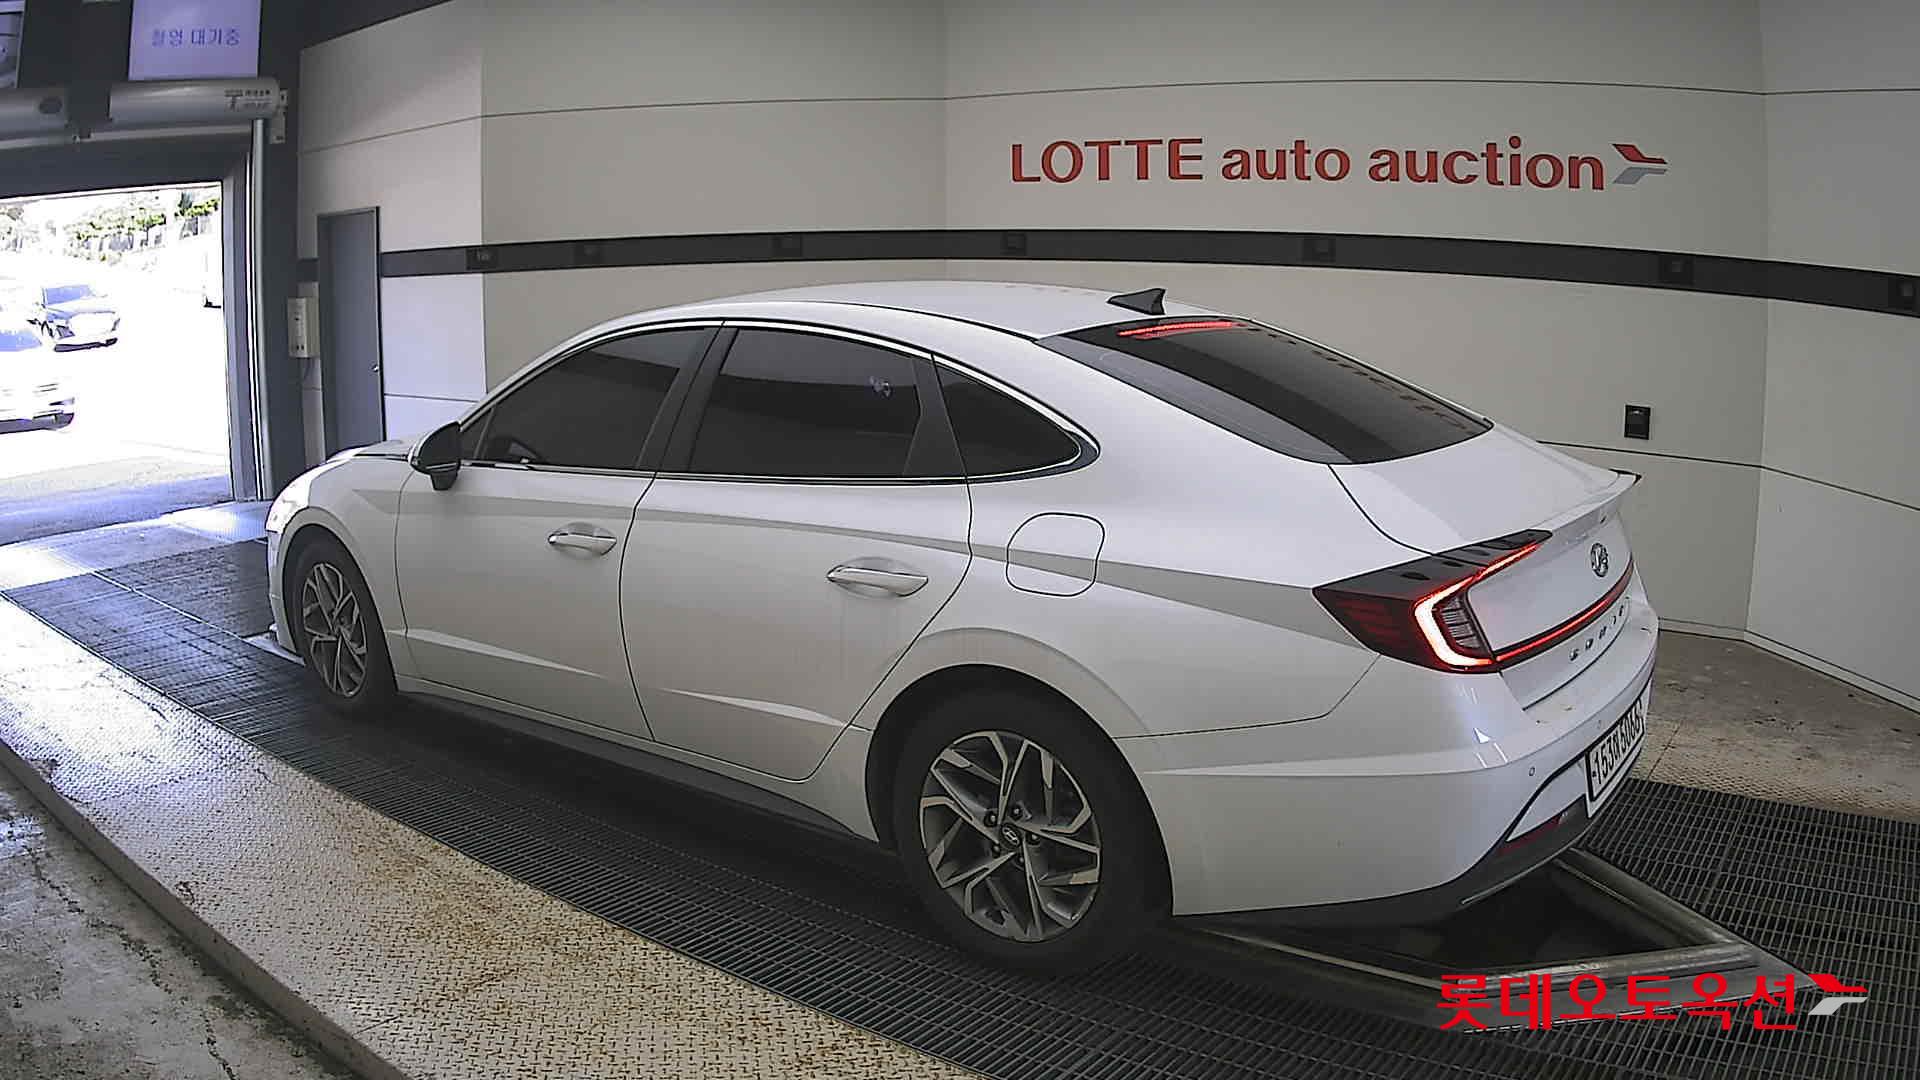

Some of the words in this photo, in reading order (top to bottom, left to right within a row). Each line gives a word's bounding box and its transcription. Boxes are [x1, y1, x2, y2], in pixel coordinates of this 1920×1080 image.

[1012, 138, 1203, 182] LOTTE
[1222, 139, 1351, 182] auto
[1368, 136, 1606, 190] auction
